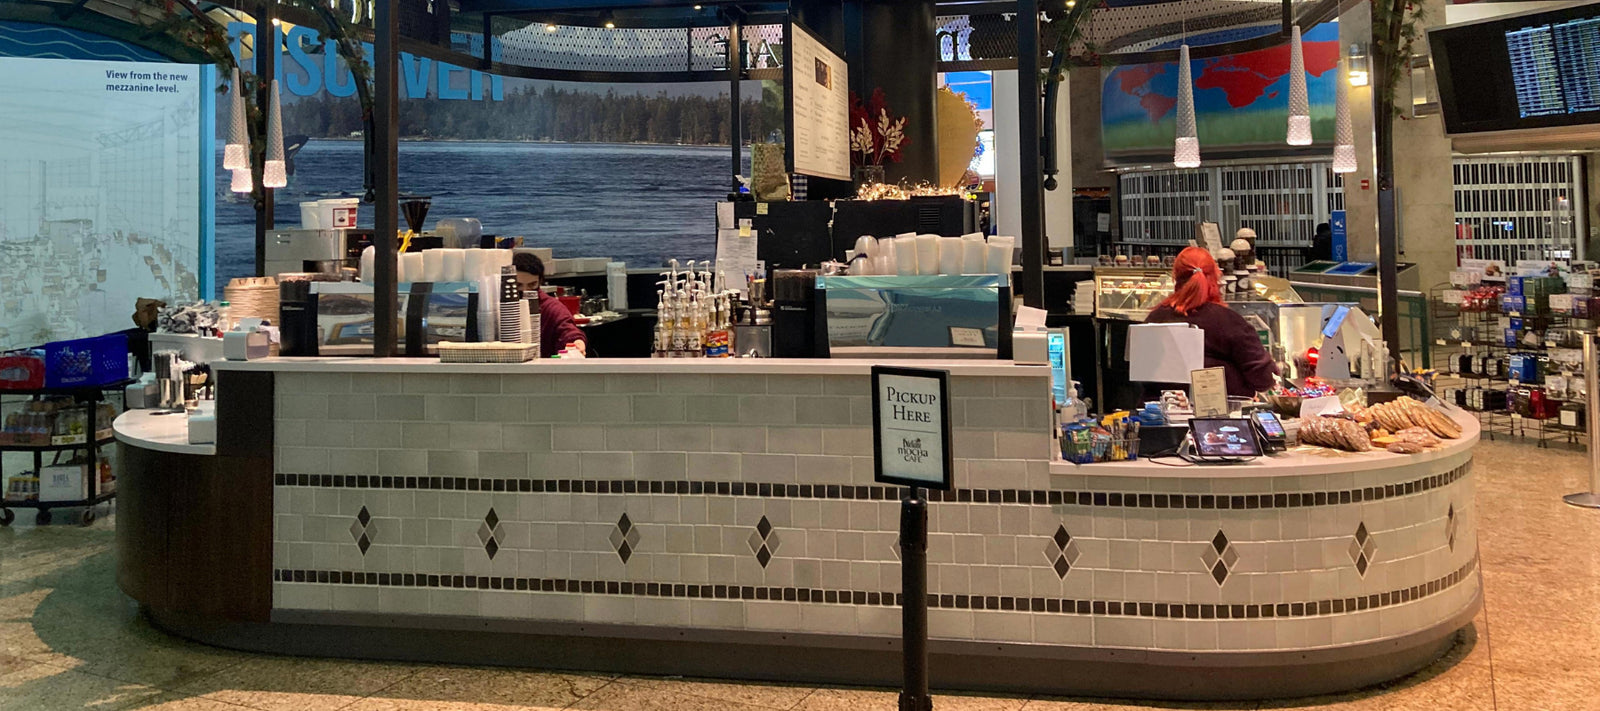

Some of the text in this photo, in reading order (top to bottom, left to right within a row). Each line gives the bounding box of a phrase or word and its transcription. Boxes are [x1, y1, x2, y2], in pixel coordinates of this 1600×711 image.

[228, 21, 504, 101] DISCVER
[106, 70, 188, 81] View from the new
[106, 83, 179, 93] mezzanine level.
[887, 387, 936, 404] PICKUP
[893, 405, 931, 422] HERE
